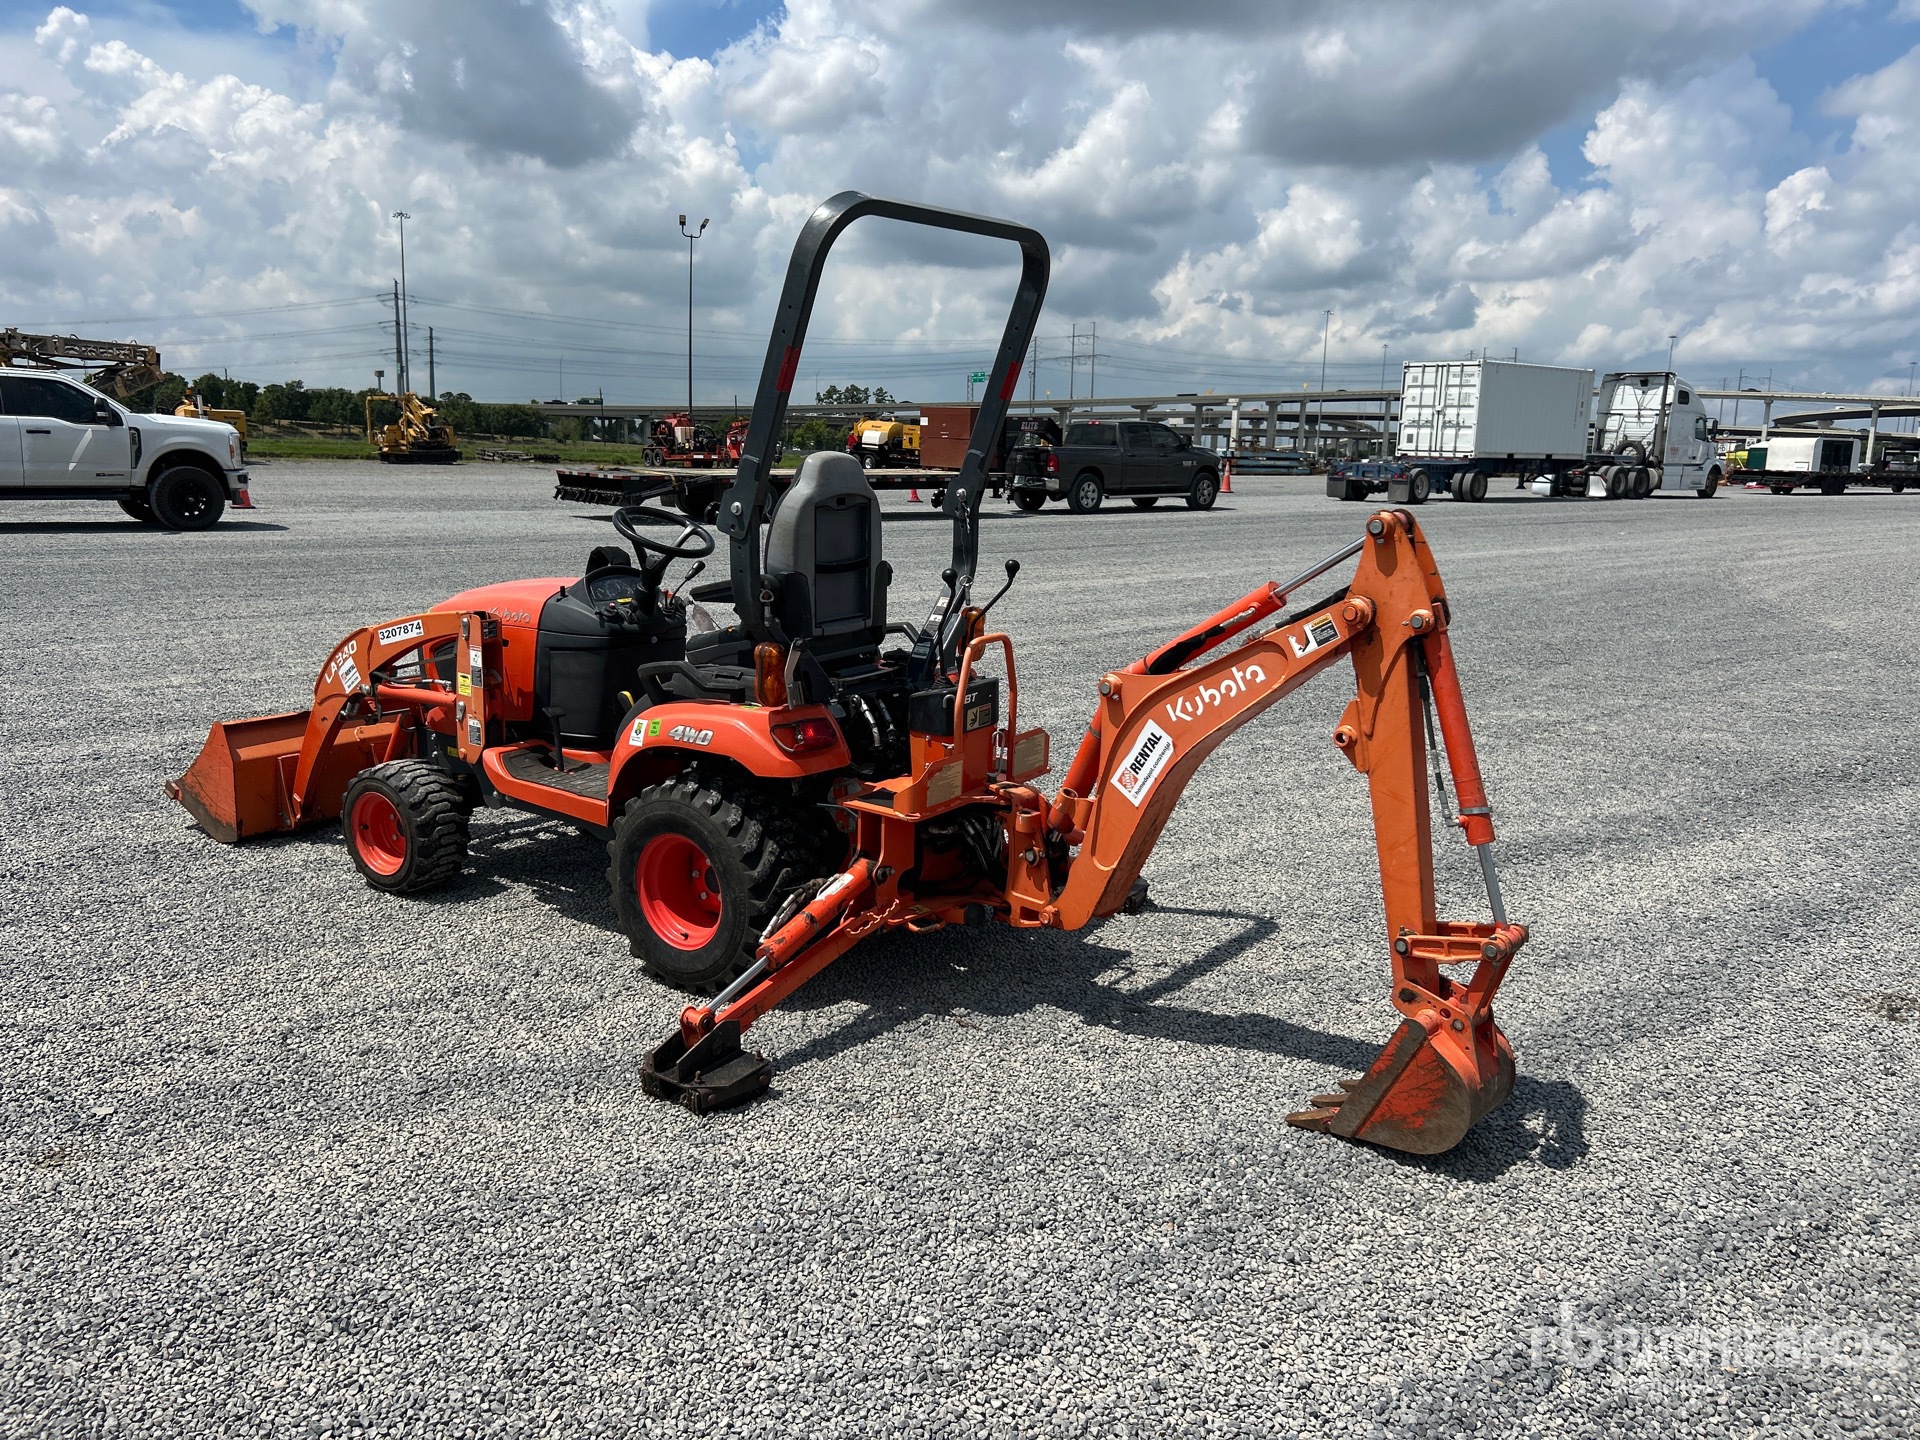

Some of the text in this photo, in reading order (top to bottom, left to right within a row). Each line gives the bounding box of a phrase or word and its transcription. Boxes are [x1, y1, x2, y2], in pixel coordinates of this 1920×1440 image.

[1020, 422, 1038, 430] ELITE
[380, 622, 422, 640] 3207874
[324, 640, 357, 684] LA340
[1166, 664, 1266, 722] Kubota
[668, 724, 714, 746] 4WD
[1130, 732, 1162, 776] RENTAL
[1135, 742, 1171, 796] homedepot.com/rental
